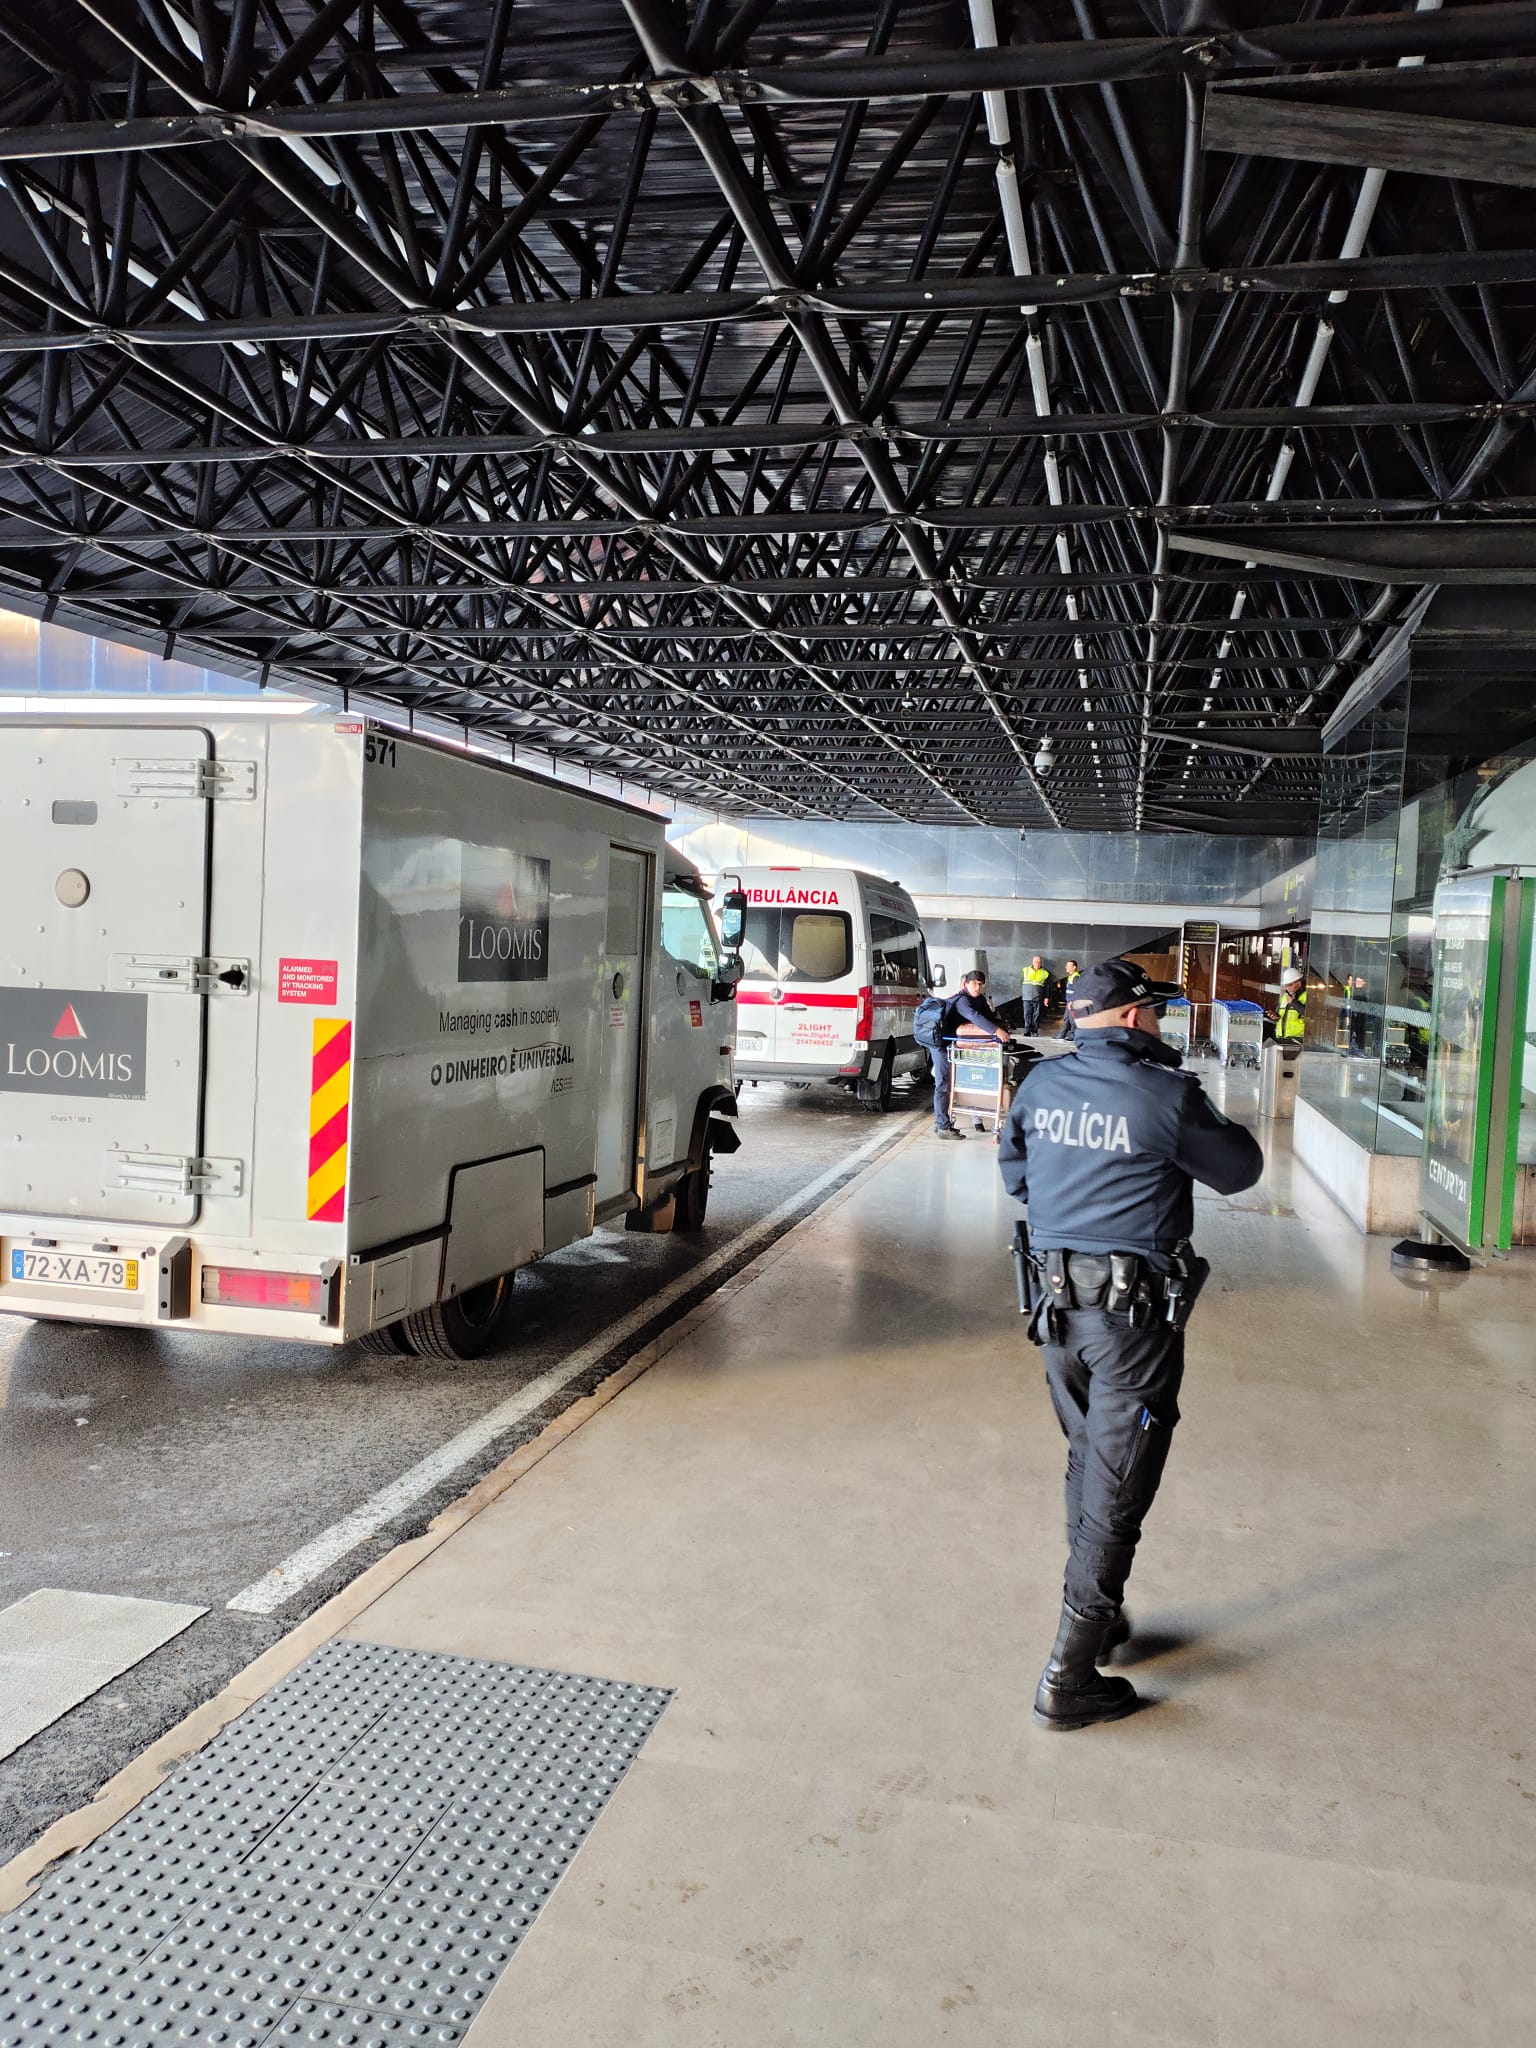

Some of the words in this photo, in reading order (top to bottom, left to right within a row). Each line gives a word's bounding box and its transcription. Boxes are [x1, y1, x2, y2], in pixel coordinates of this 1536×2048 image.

[365, 735, 396, 769] 571
[732, 887, 838, 905] MBULÂNCIA
[468, 919, 542, 960] LOOMIS
[282, 965, 313, 973] ALARMED
[296, 974, 334, 982] MONITORED
[292, 982, 324, 990] TRACKING
[281, 989, 307, 997] SYSTEM
[439, 1010, 492, 1034] Managing
[494, 1008, 518, 1028] cash
[519, 1008, 528, 1026] in
[798, 1023, 832, 1032] 2LIGHT
[7, 1043, 132, 1082] LOOMIS
[431, 1064, 442, 1086] O
[445, 1055, 508, 1084] DINHEIRO
[1035, 1102, 1132, 1154] POLÍCIA
[127, 1263, 137, 1271] 08
[127, 1278, 136, 1287] 10
